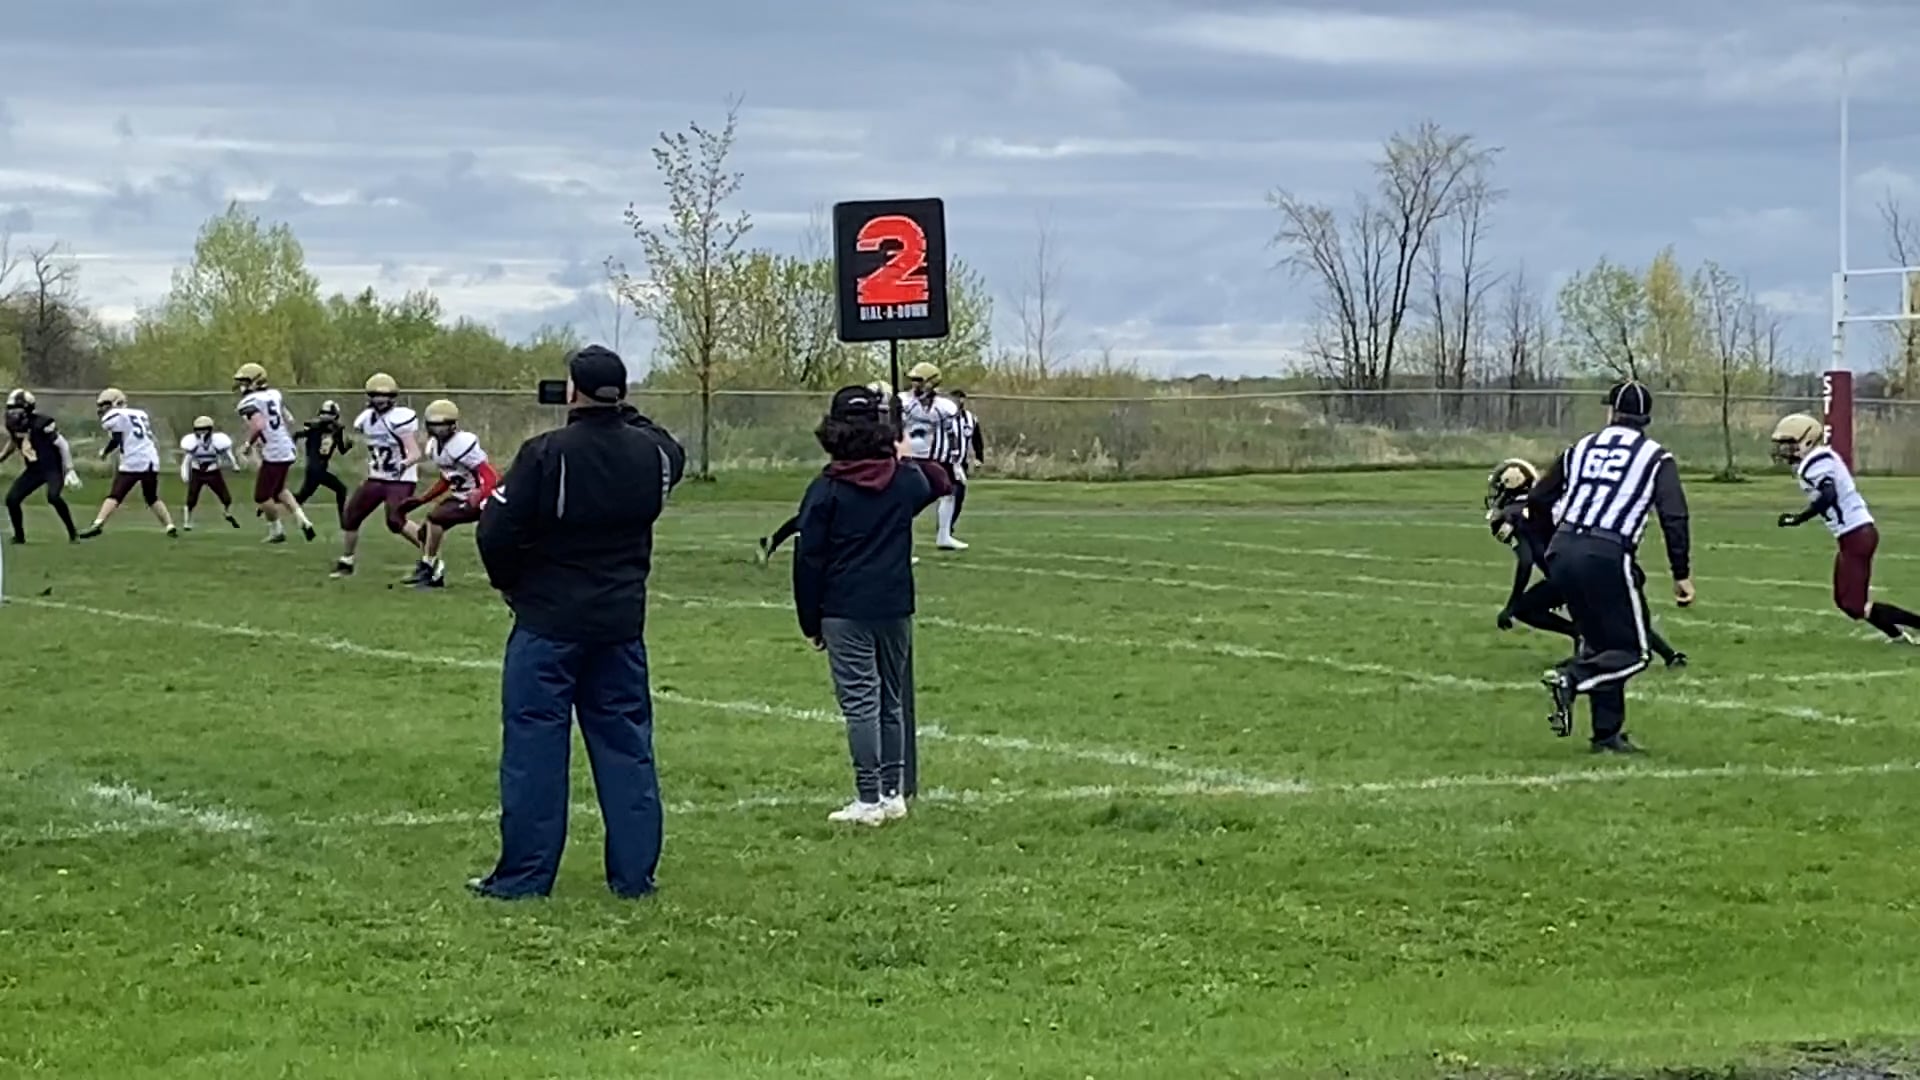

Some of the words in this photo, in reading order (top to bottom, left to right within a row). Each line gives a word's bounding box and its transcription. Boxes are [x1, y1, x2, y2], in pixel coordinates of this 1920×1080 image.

[856, 215, 929, 304] 2
[267, 400, 281, 430] 5
[1581, 447, 1632, 481] 62
